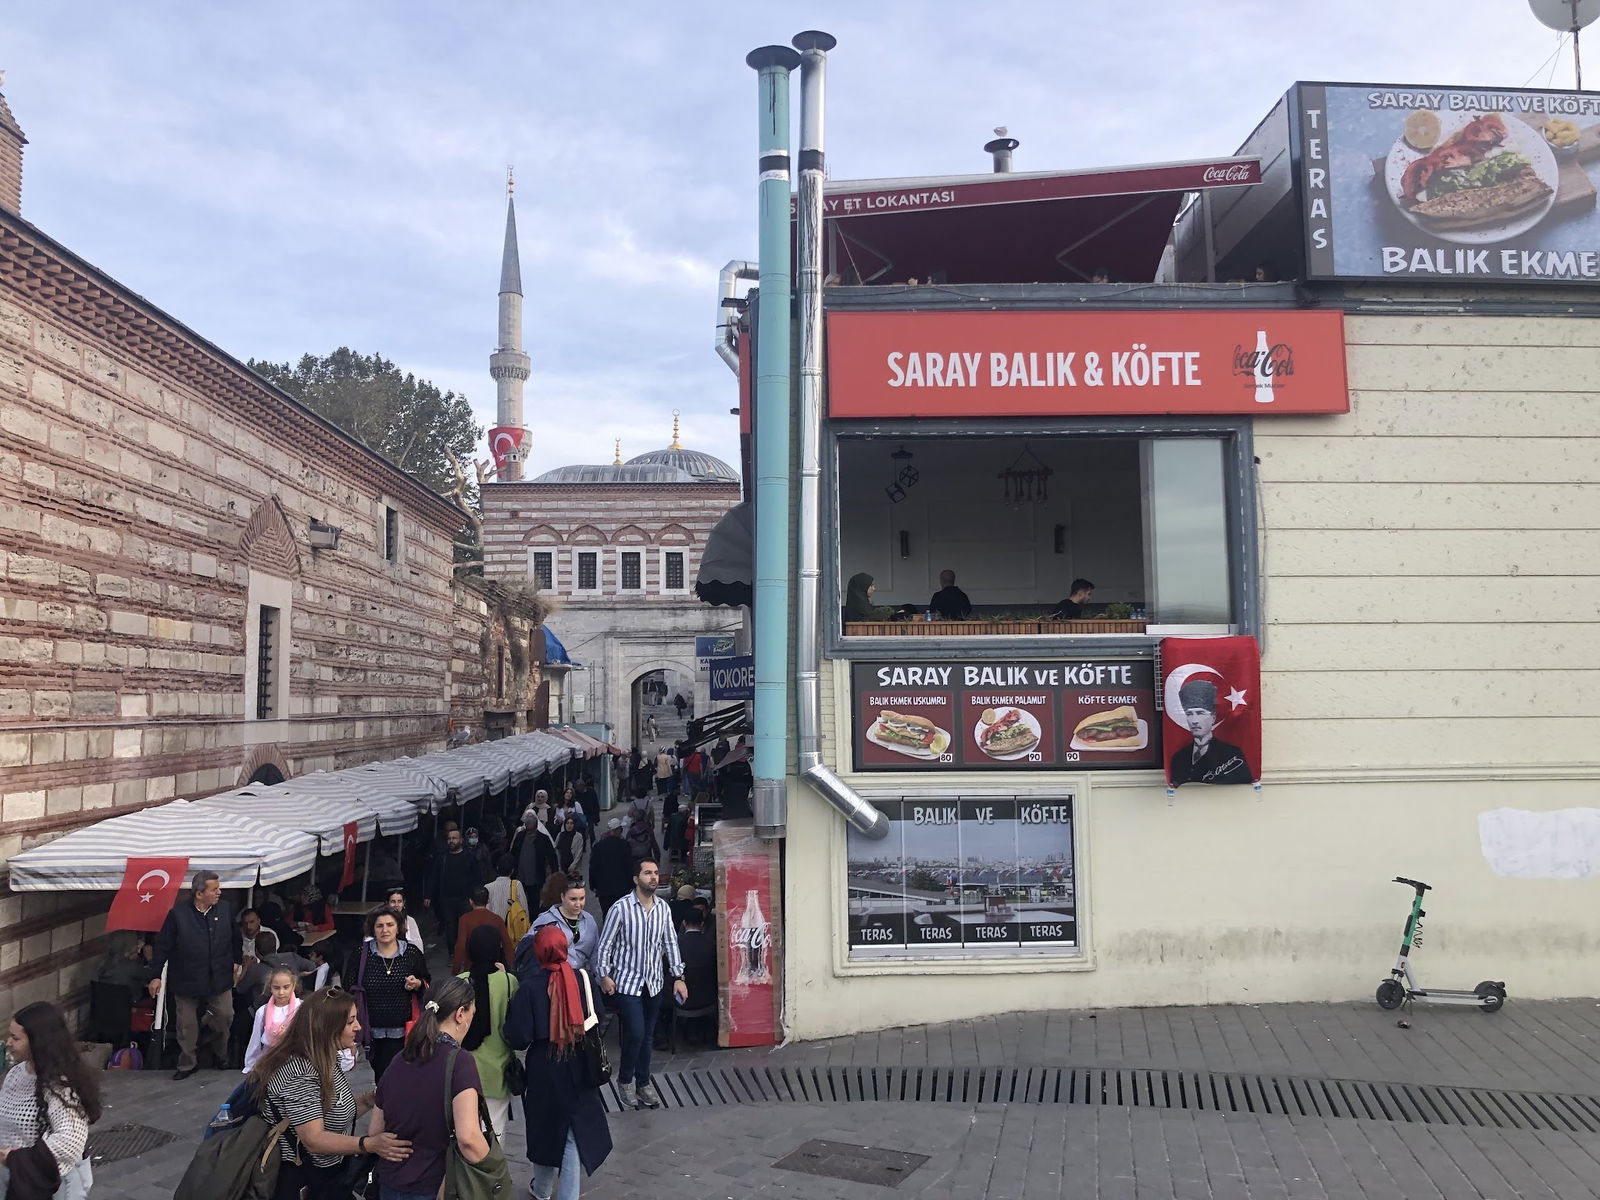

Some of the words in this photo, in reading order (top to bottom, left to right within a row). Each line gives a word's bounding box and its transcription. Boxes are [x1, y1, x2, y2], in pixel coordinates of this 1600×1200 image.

[1367, 91, 1443, 111] SARAY
[1449, 94, 1512, 112] BALIK
[1517, 96, 1545, 113] VE
[1203, 164, 1251, 183] Coca-Cola
[1306, 109, 1328, 250] TERAS
[844, 198, 862, 211] ET
[866, 191, 955, 209] LOKANTASI
[1381, 247, 1490, 274] BALIK
[887, 351, 982, 388] SARAY
[990, 351, 1076, 387] BALIK
[1083, 351, 1104, 388] &
[1112, 343, 1202, 387] KÖFTE
[877, 666, 952, 687] SARAY
[963, 665, 1029, 687] BALIK
[1033, 669, 1059, 686] VE
[1064, 663, 1132, 686] KÖFTE
[869, 696, 889, 706] BALIK
[890, 696, 912, 706] EKMEK
[913, 696, 947, 706] USKUMRU
[971, 695, 991, 705] BALIK
[992, 695, 1014, 705] EKMEK
[1015, 695, 1047, 705] PALAMUT
[1078, 694, 1106, 705] KÖFTE
[1107, 695, 1138, 704] EKMEK
[940, 754, 952, 762] 80
[1029, 753, 1041, 761] 90
[1067, 753, 1078, 761] 90
[913, 806, 958, 825] BALIK
[975, 806, 994, 825] VE
[1020, 804, 1069, 825] KÖFTE
[861, 927, 893, 942] TERAS
[920, 926, 953, 940] TERAS
[975, 926, 1007, 939] TERAS
[1029, 924, 1063, 938] TERAS
